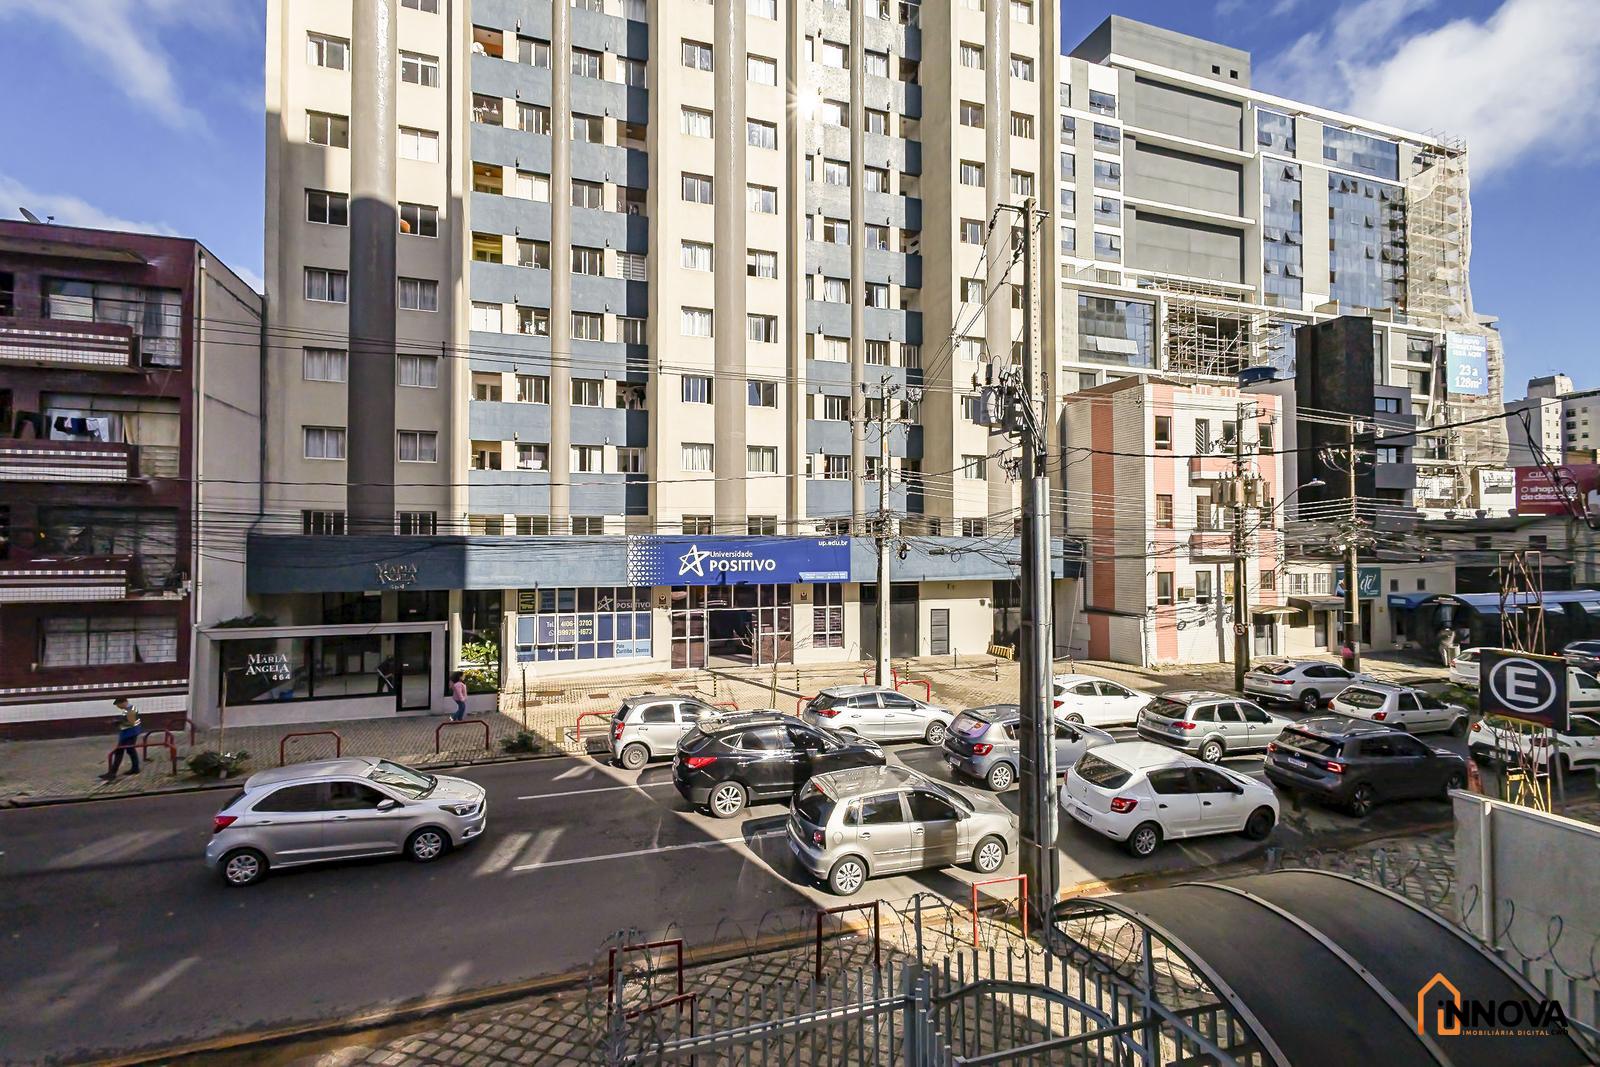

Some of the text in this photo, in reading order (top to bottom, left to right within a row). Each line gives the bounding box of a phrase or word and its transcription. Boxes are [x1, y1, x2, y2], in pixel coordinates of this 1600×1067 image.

[1459, 364, 1478, 377] 23 a
[710, 550, 753, 558] Universidade
[709, 559, 776, 572] POSITIVO
[248, 654, 287, 664] MARIA
[245, 664, 289, 675] ANGELA
[1506, 666, 1539, 704] E
